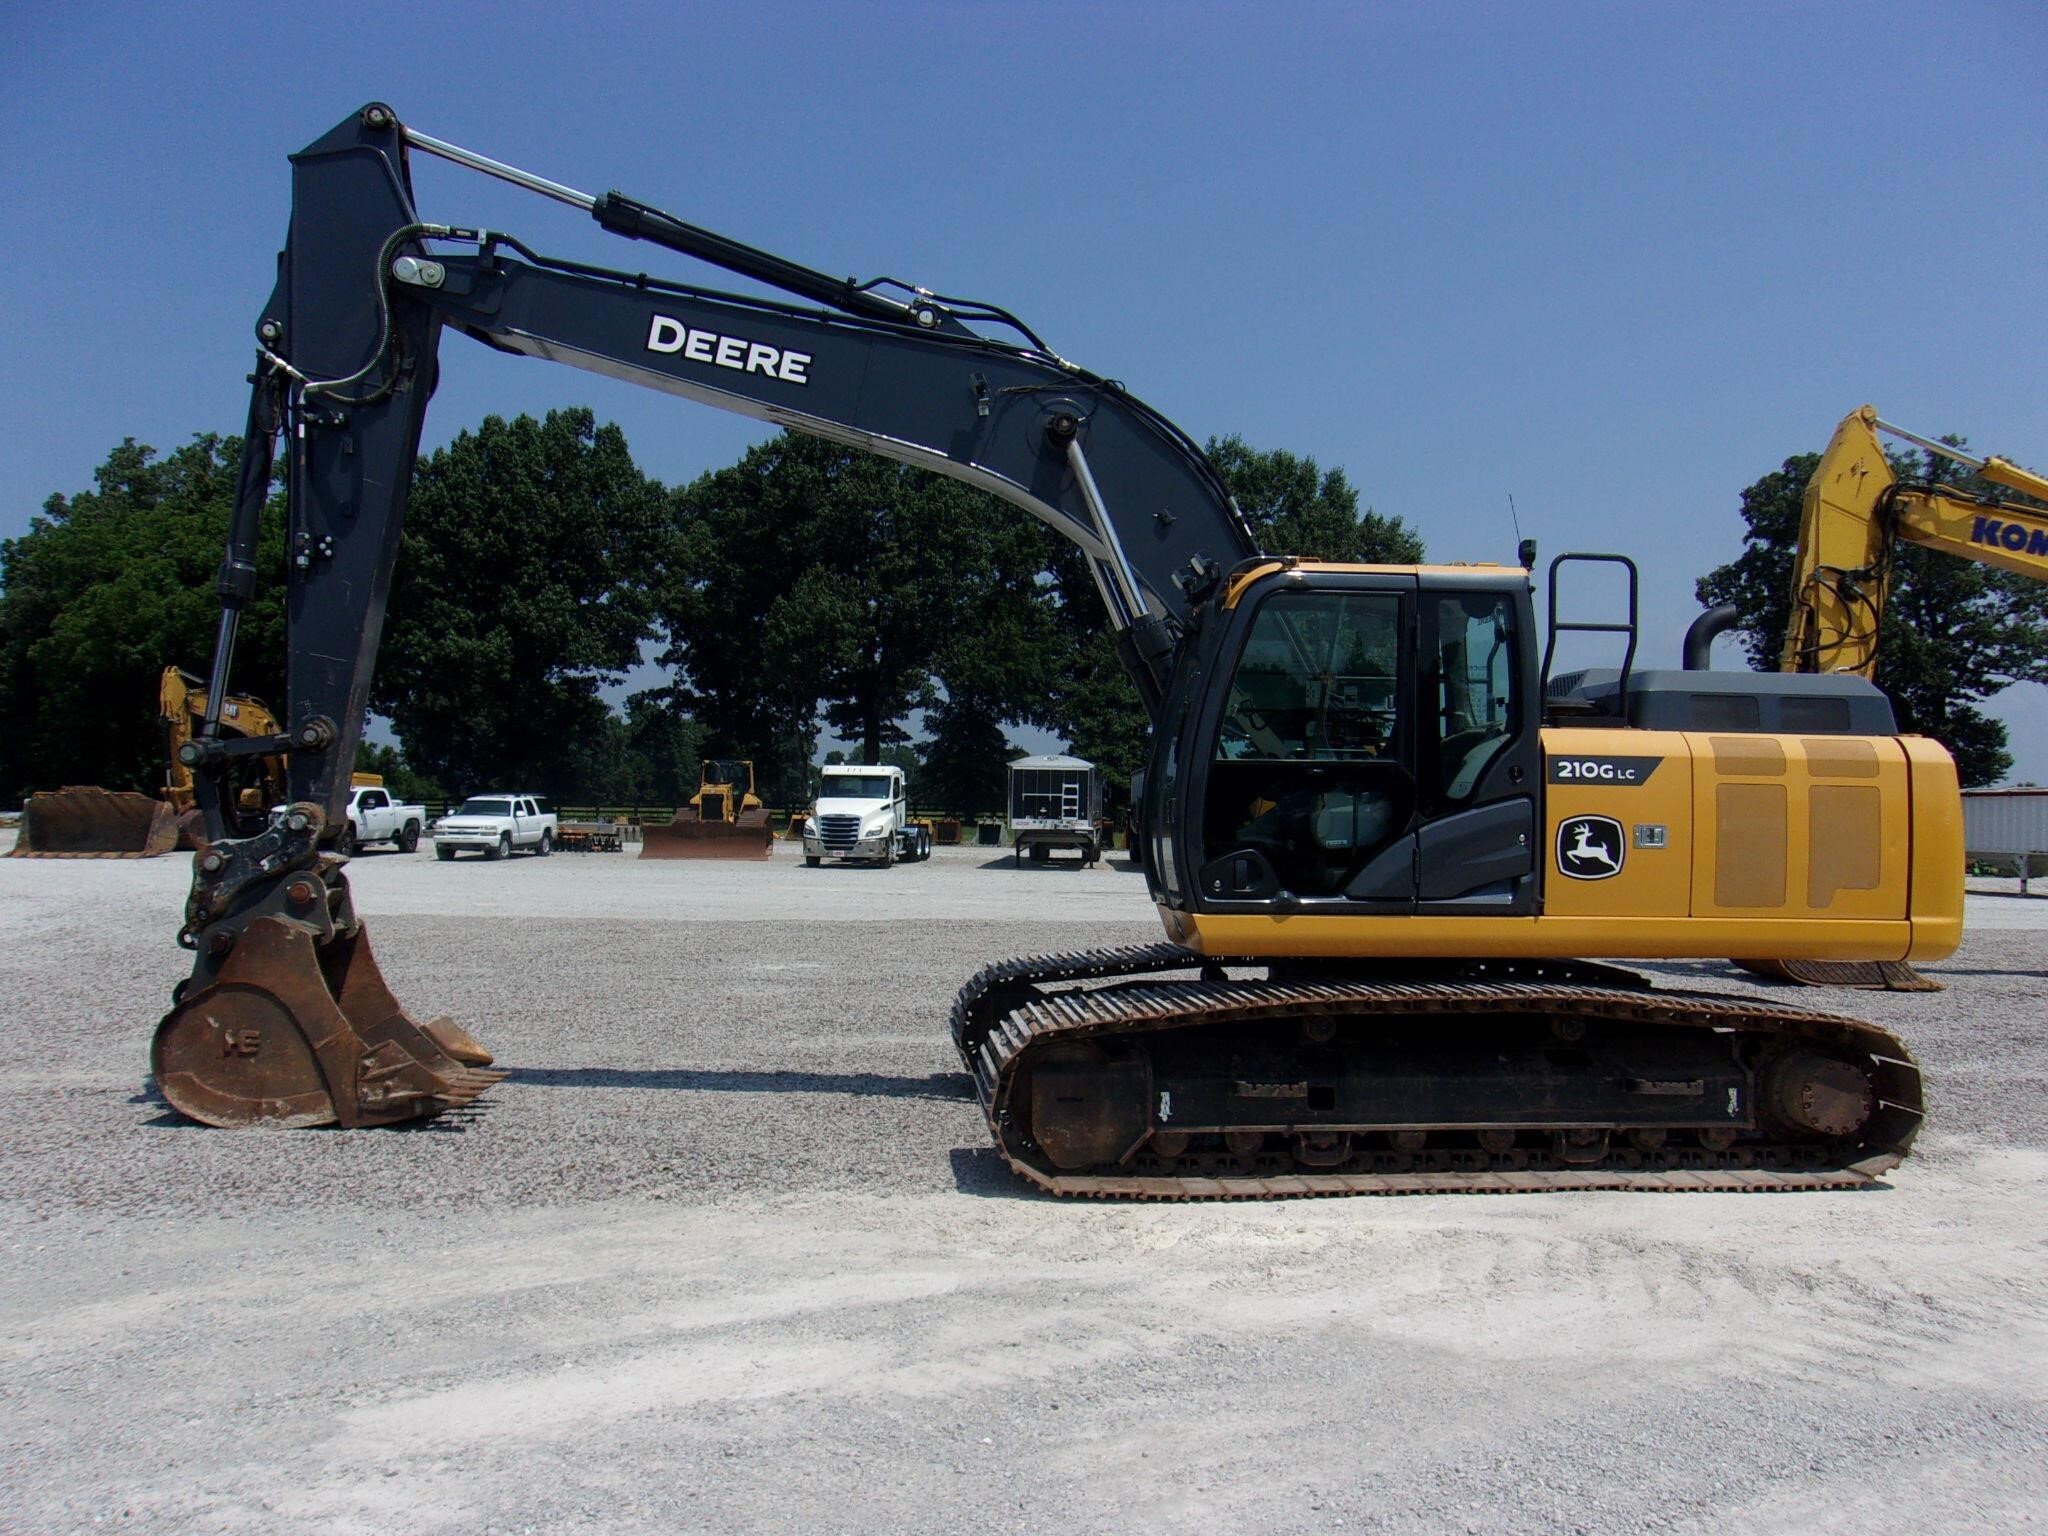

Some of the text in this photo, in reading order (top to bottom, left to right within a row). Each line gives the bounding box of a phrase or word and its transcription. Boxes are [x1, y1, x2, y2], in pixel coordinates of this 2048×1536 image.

[648, 314, 811, 384] DEERE
[1558, 761, 1635, 779] 210G LC
